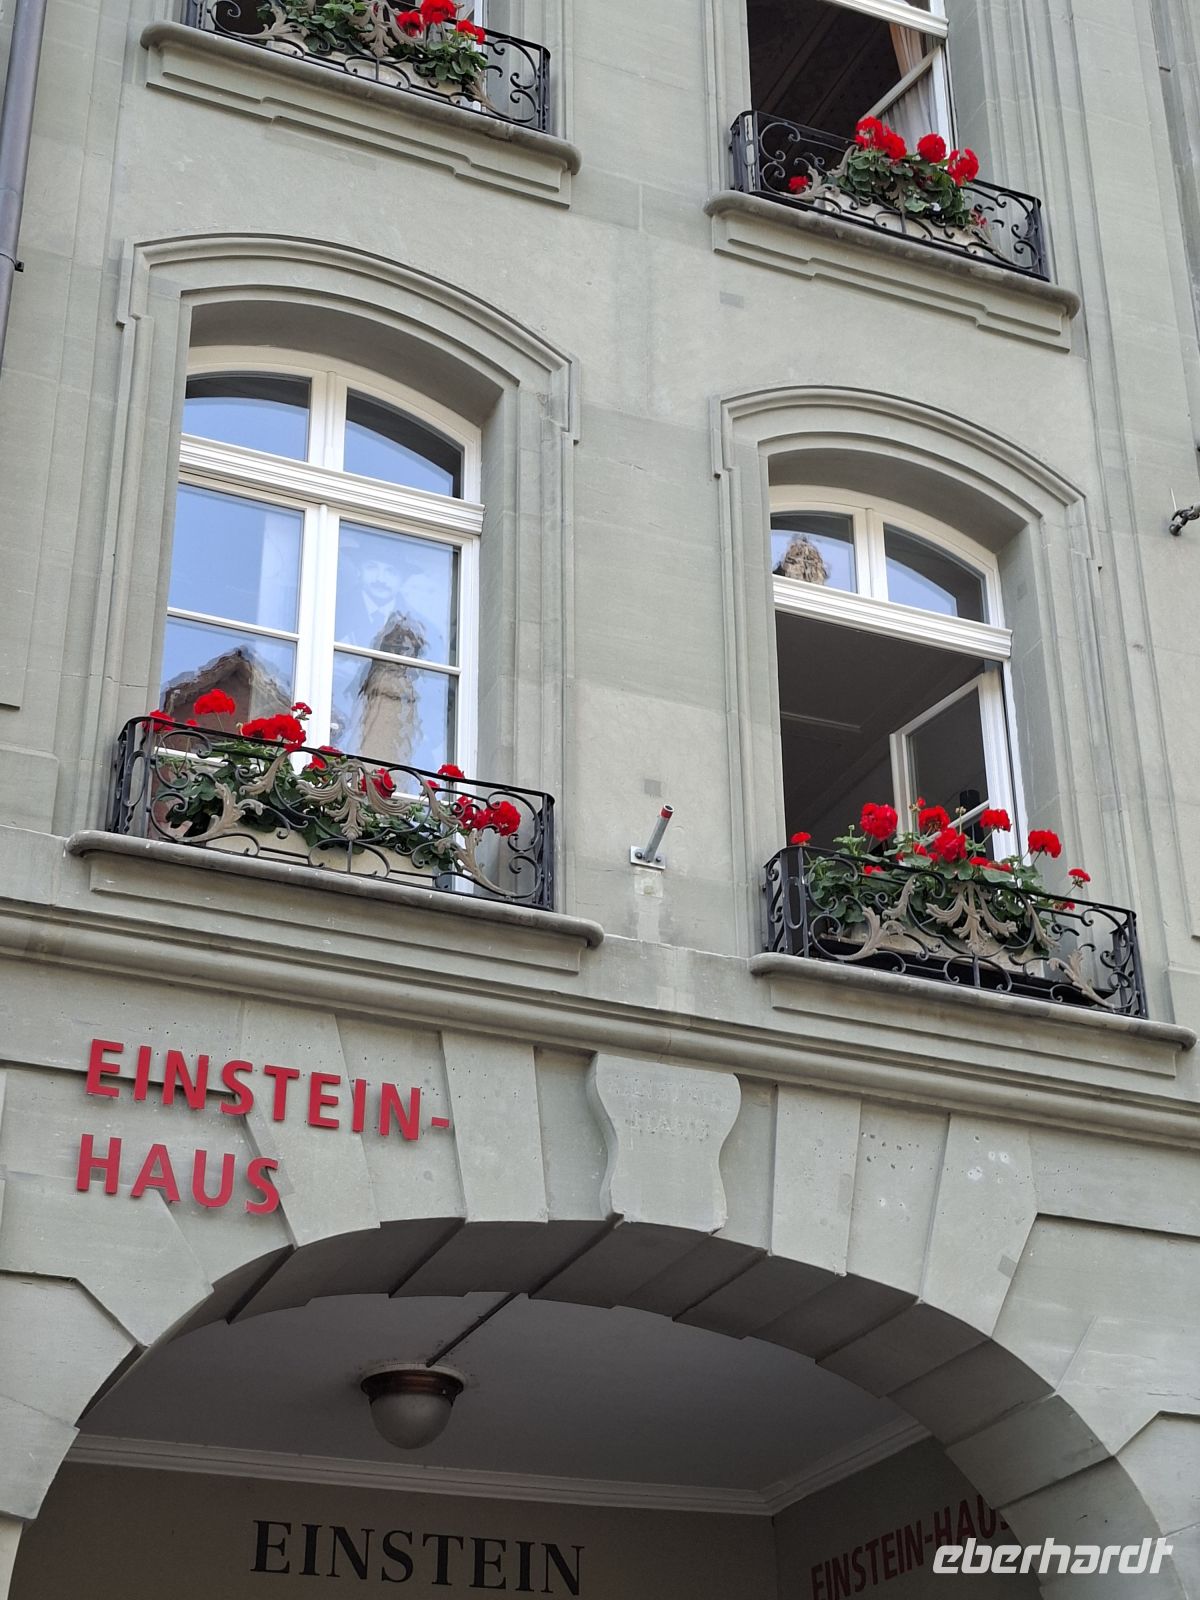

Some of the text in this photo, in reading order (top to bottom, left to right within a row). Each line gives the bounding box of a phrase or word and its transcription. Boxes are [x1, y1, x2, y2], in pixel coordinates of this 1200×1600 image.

[86, 1039, 451, 1141] EINSTEIN-
[76, 1134, 280, 1214] HAUS
[250, 1519, 585, 1596] EINSTEIN
[811, 1494, 1009, 1600] EINSTEIN-HAU
